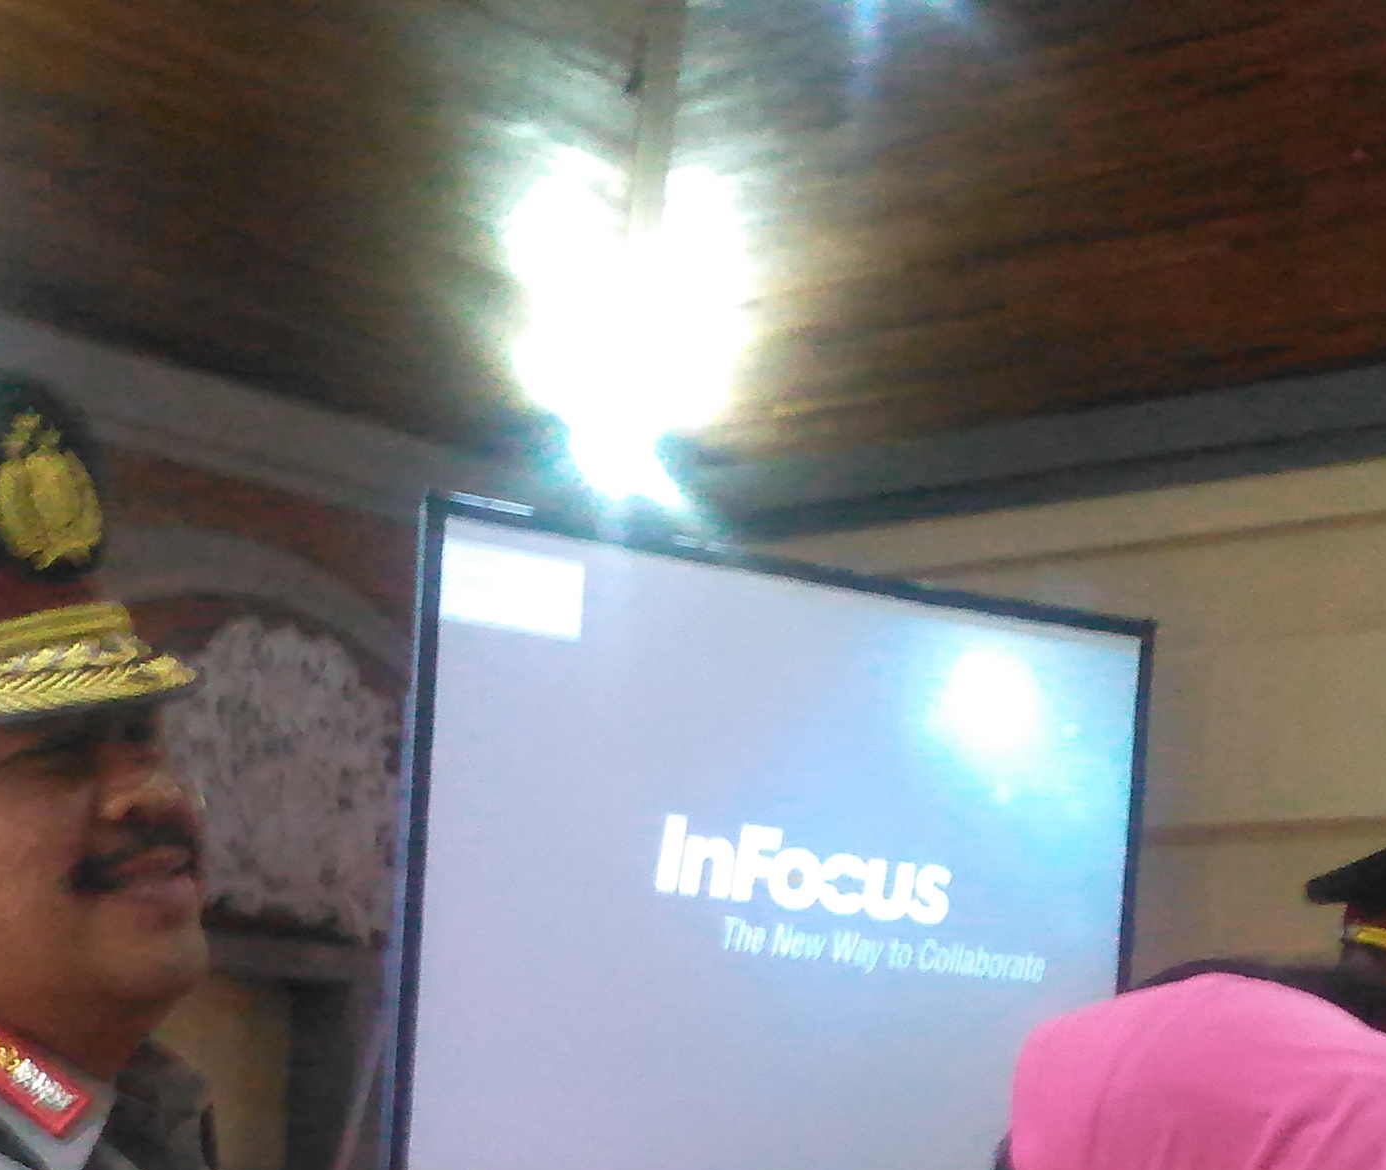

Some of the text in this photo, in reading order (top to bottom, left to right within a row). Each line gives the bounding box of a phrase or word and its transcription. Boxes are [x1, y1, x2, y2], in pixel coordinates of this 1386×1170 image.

[722, 916, 1047, 984] The New Way to Collaborate
